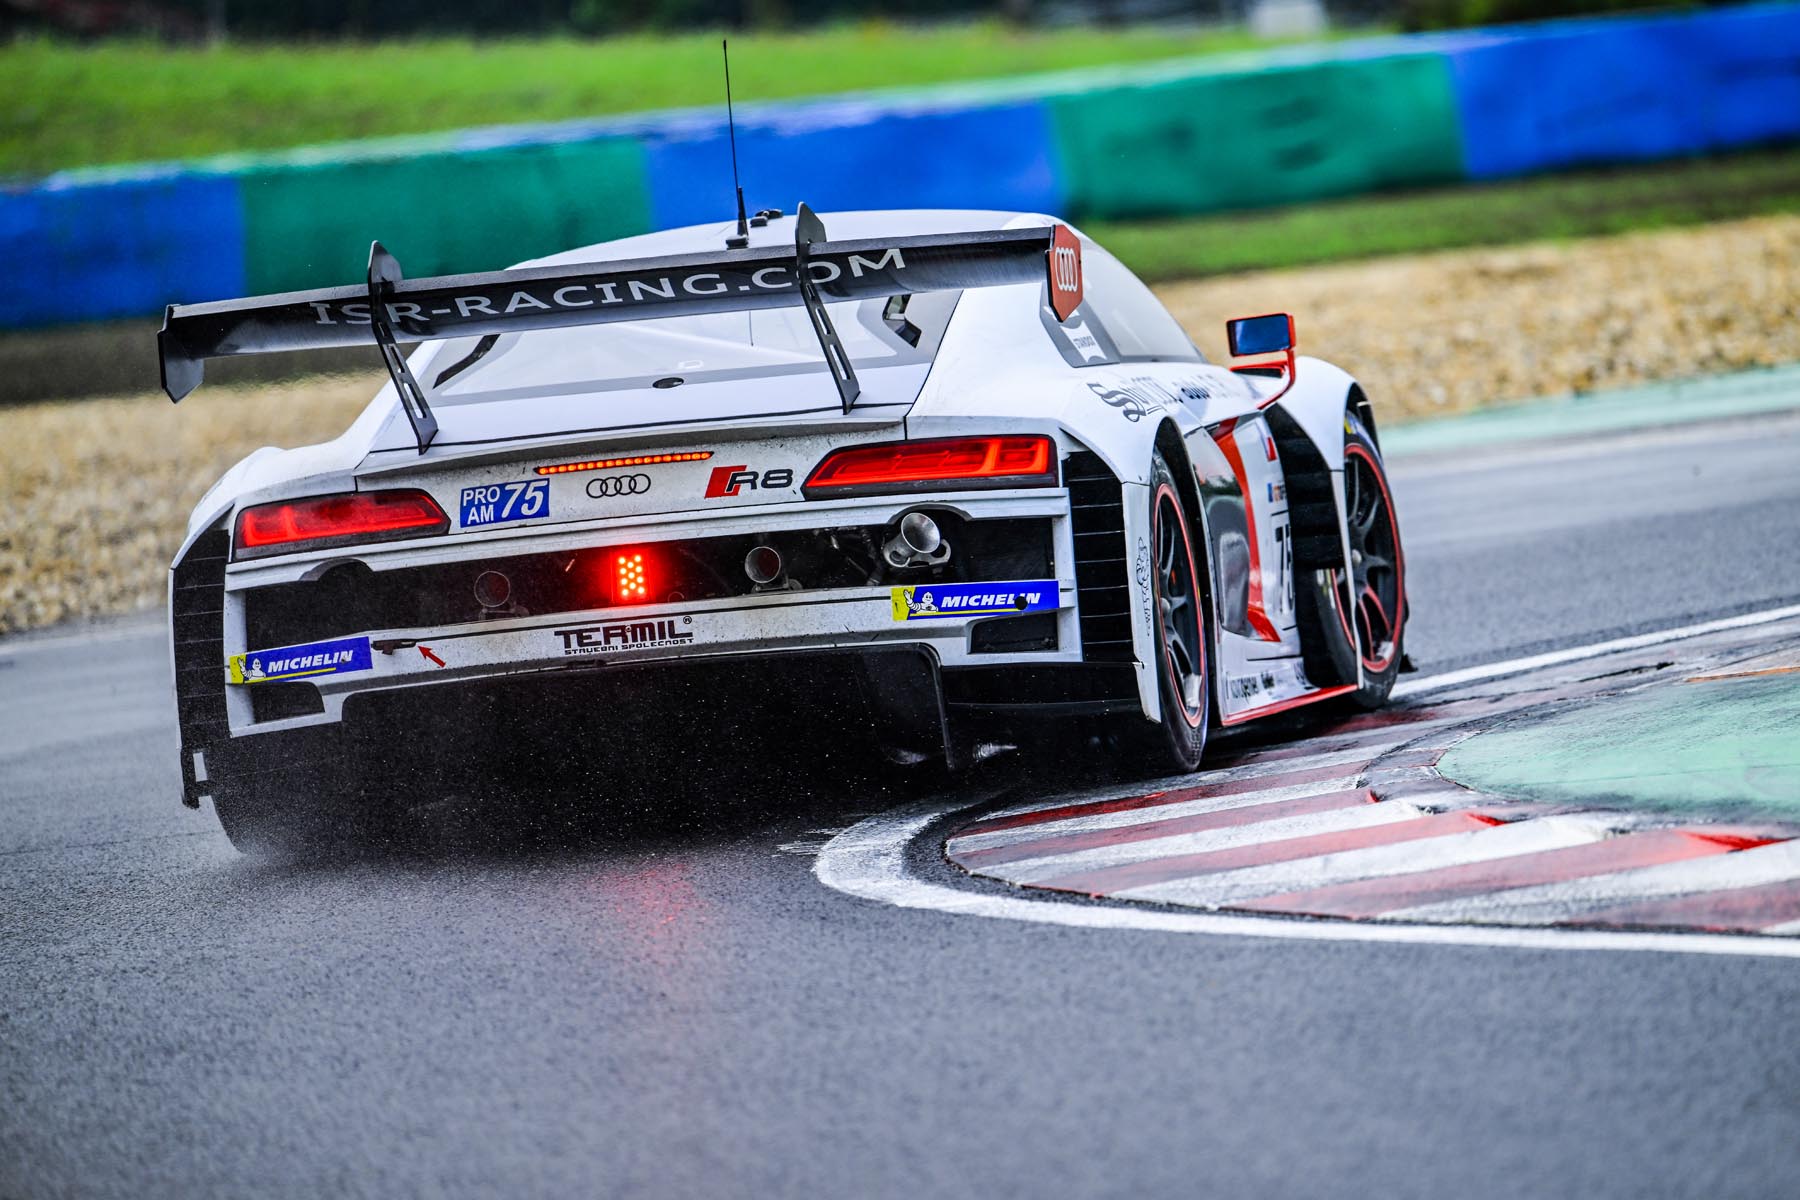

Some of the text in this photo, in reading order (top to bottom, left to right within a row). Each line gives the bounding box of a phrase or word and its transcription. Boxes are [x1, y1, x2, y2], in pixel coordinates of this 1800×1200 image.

[308, 247, 906, 326] ISR-RACING.COM
[725, 468, 794, 493] R8
[462, 486, 501, 507] PRO
[501, 480, 549, 518] 75
[467, 504, 495, 525] AM
[621, 637, 695, 650] SPOLECNOST
[267, 649, 354, 673] MICHELIN
